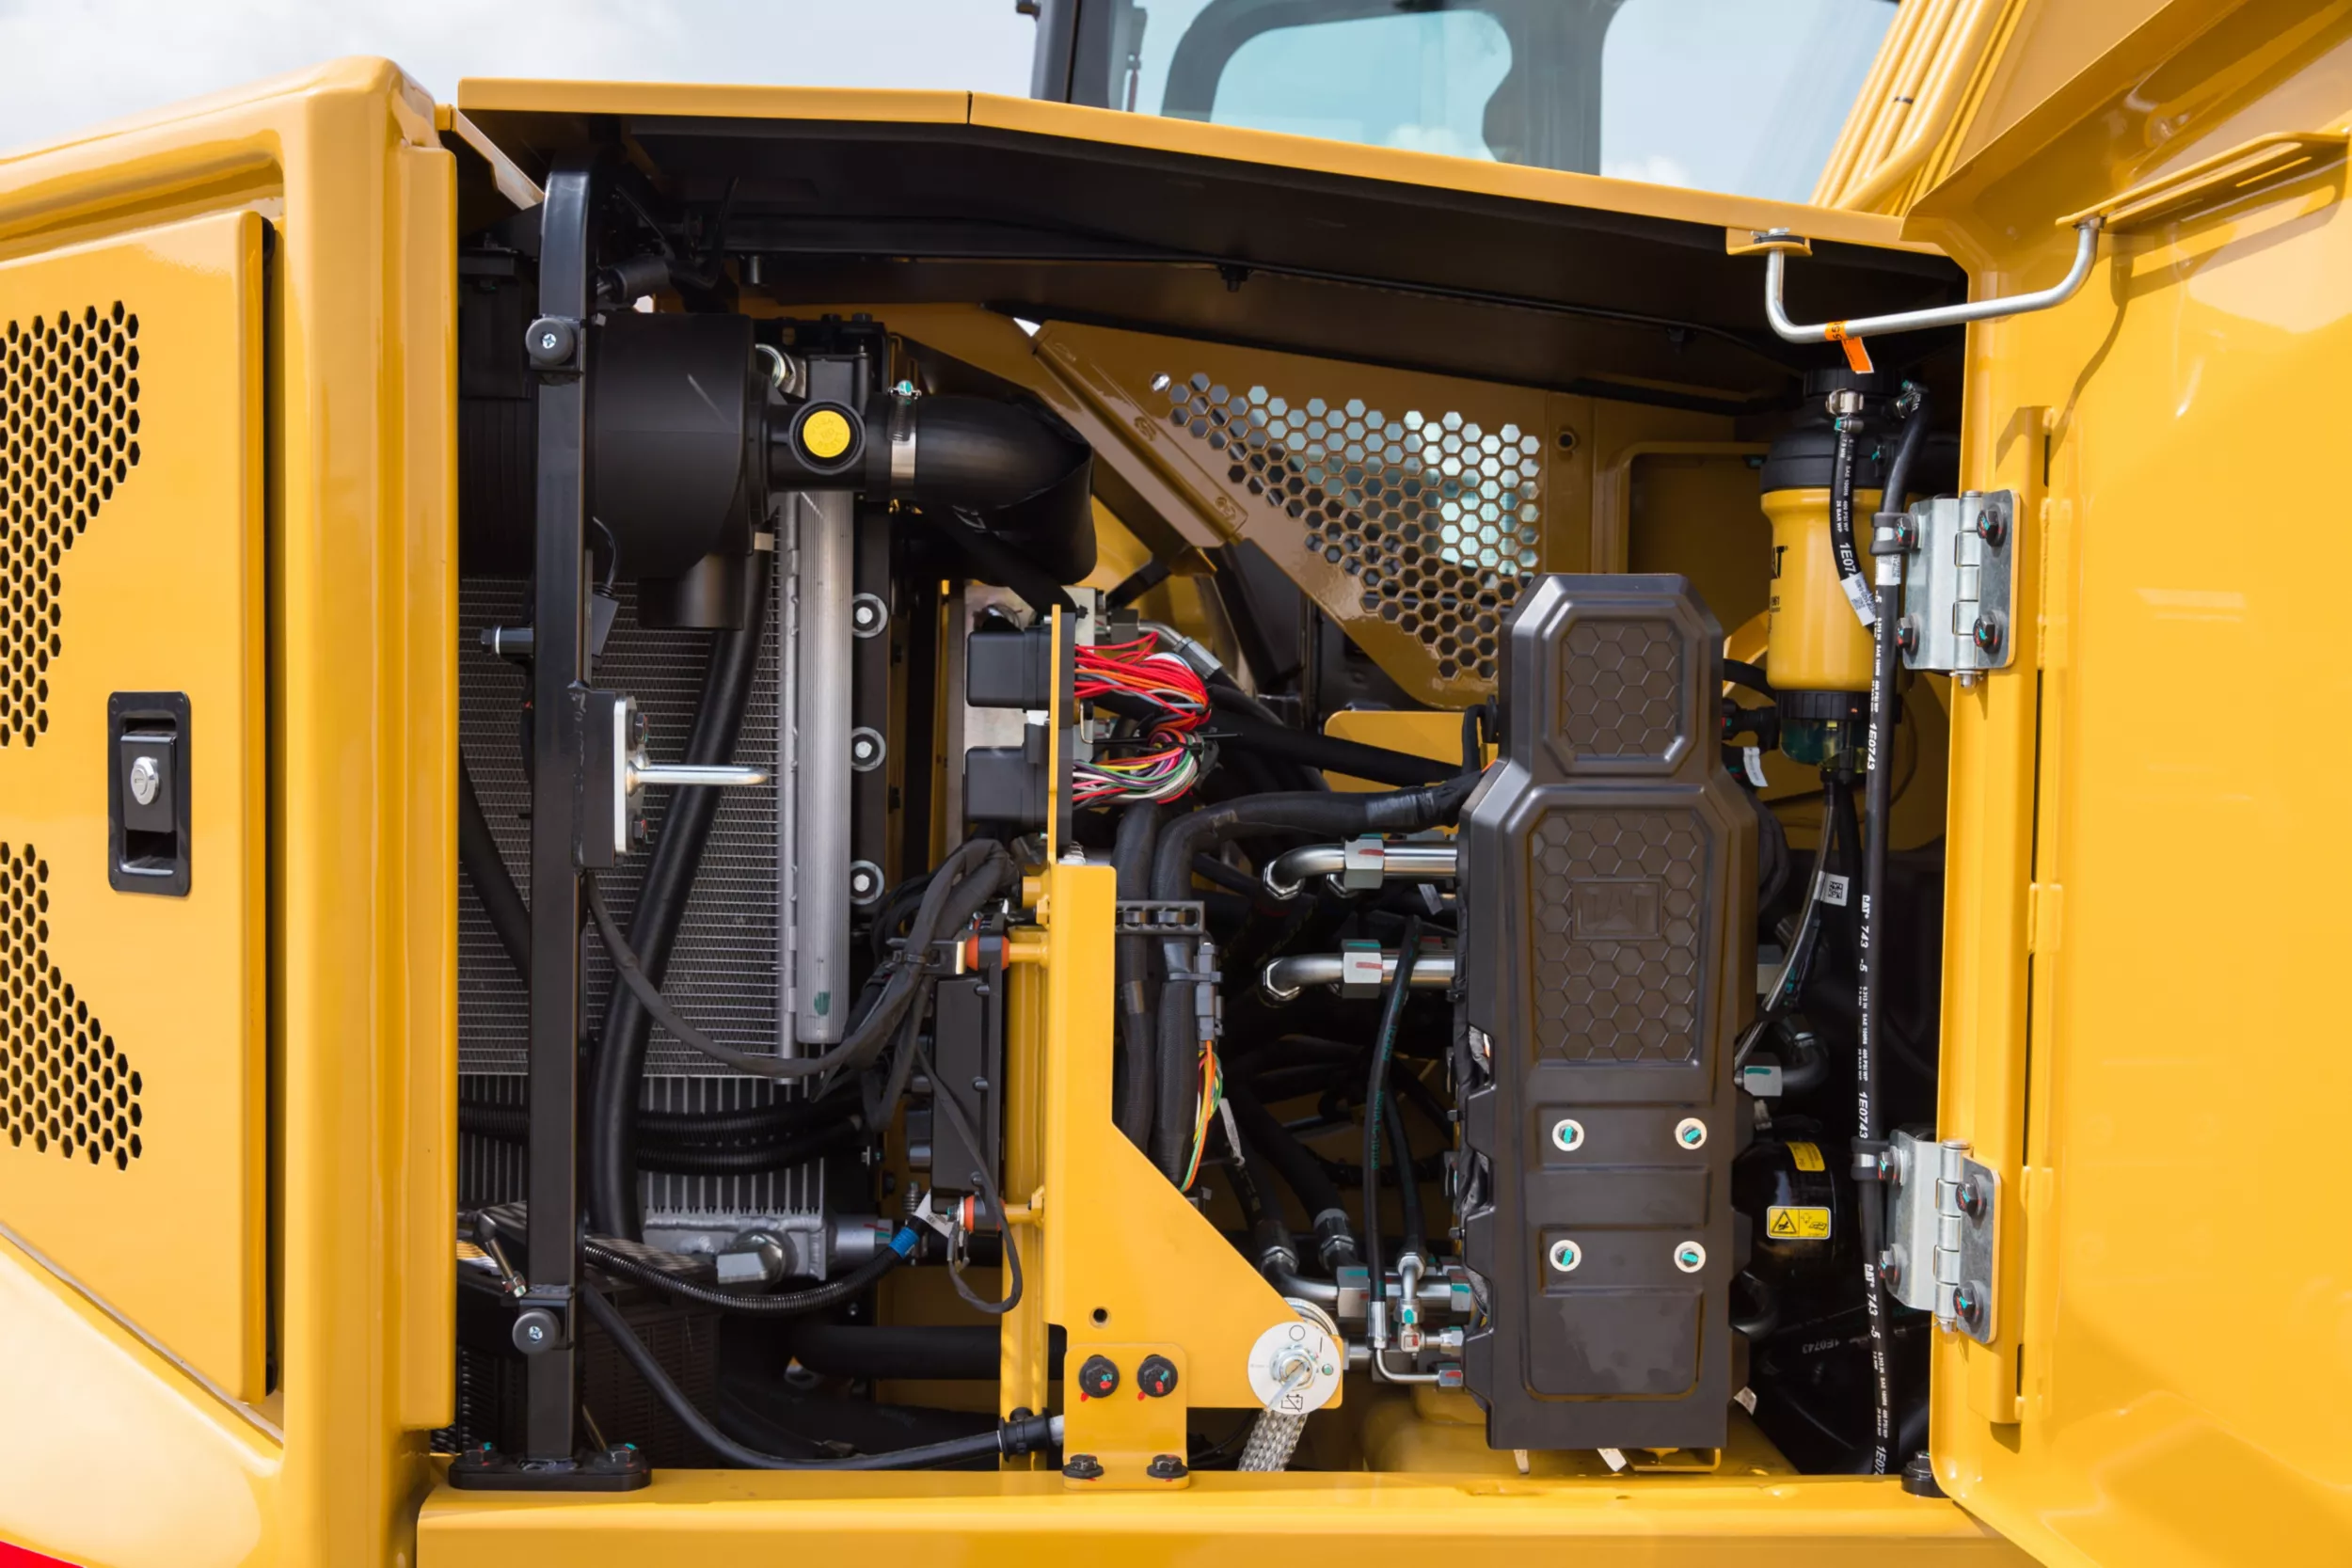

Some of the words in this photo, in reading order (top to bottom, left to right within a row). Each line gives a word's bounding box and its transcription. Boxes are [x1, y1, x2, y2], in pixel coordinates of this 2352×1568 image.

[1867, 722, 1878, 770] 1E0743
[1860, 926, 1869, 948] 743
[1859, 958, 1868, 973] -5
[1859, 1091, 1868, 1139] 1E0743
[1867, 1292, 1879, 1316] 743
[1870, 1324, 1882, 1339] -5
